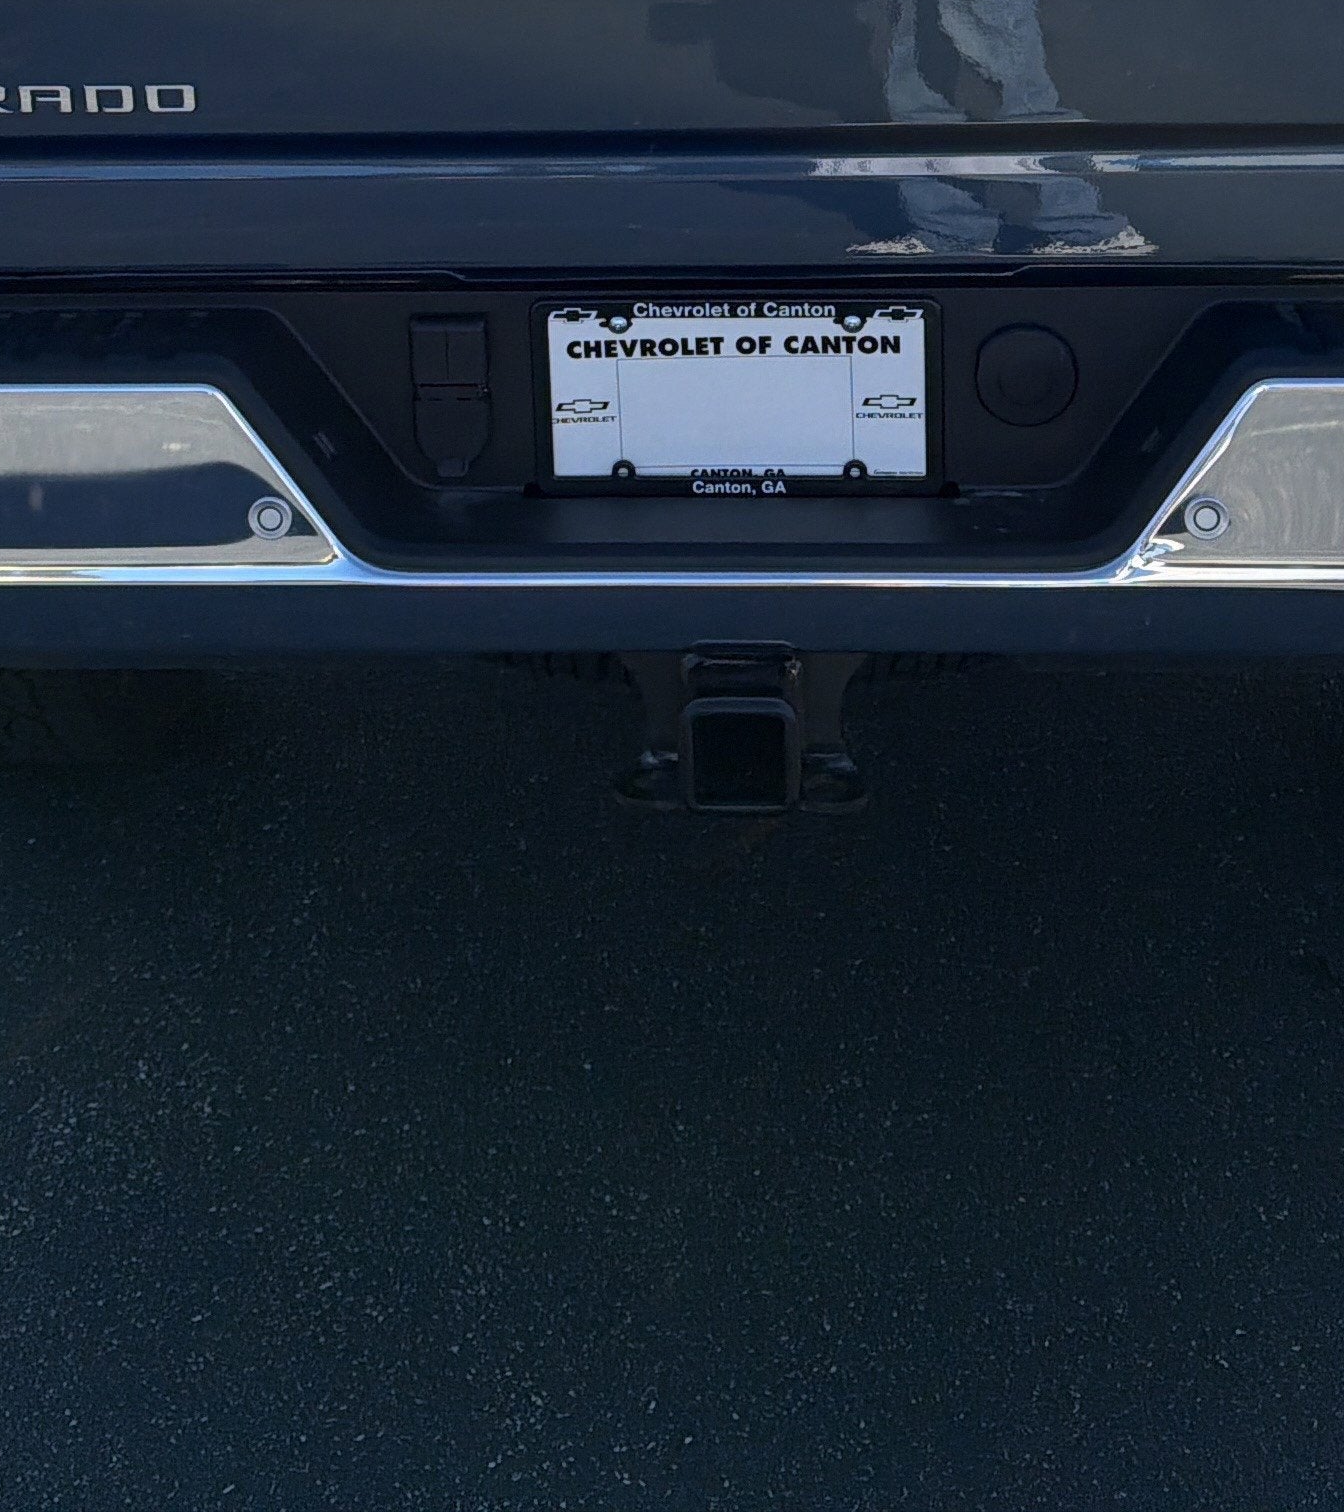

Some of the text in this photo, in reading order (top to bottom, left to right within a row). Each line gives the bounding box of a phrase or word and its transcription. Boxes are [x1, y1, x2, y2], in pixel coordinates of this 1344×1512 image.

[632, 301, 836, 318] Chevrolet of Canton
[566, 335, 901, 359] CHEVROLET OF CANTON
[690, 468, 758, 477] CANTON
[692, 480, 787, 496] Canton, GA
